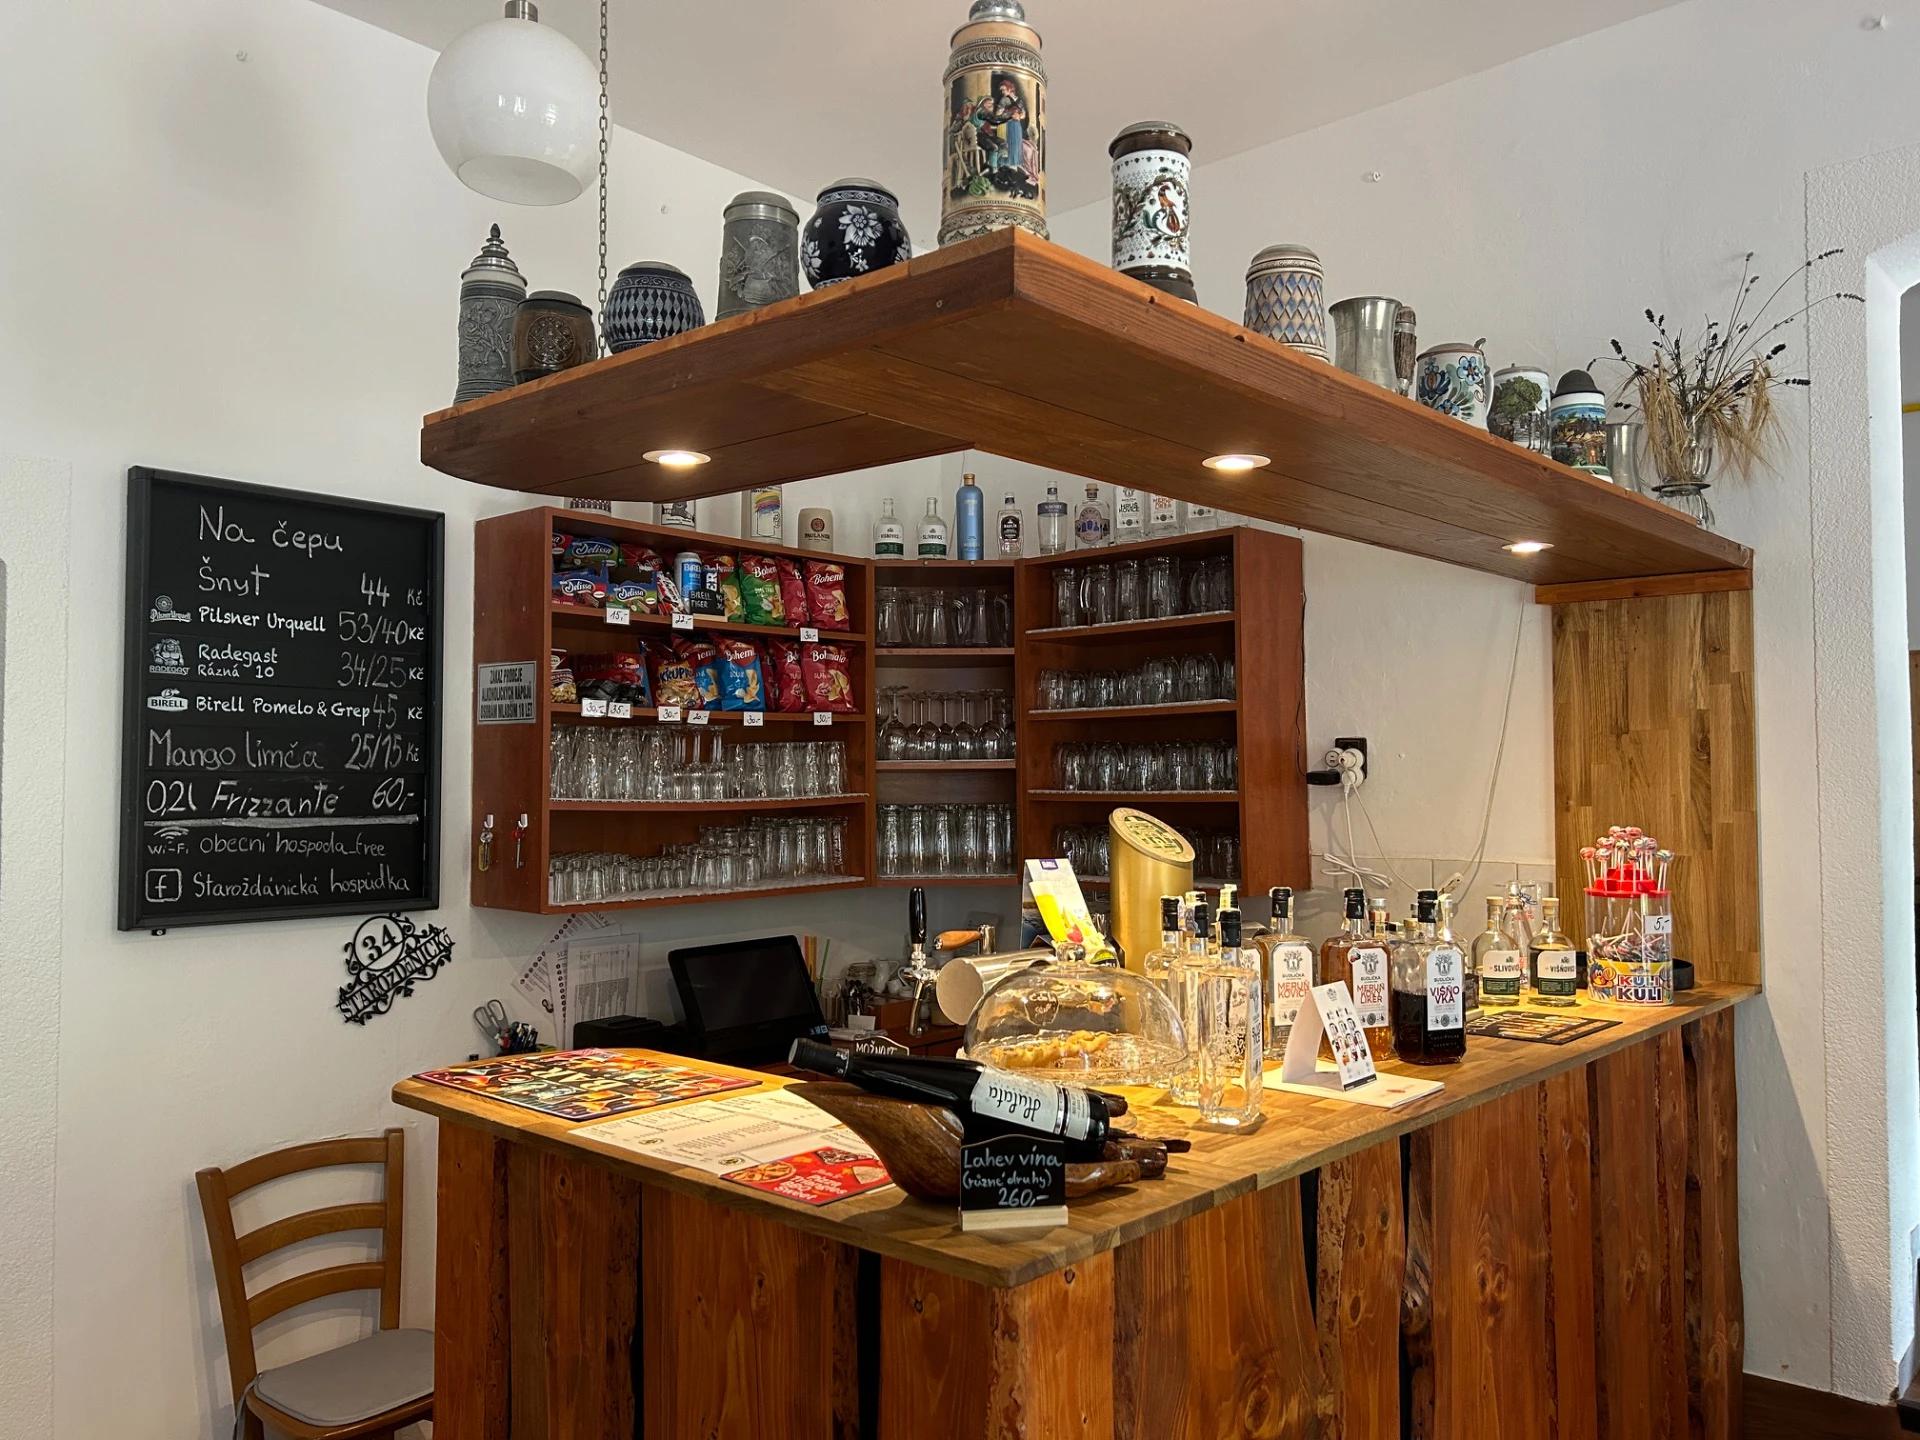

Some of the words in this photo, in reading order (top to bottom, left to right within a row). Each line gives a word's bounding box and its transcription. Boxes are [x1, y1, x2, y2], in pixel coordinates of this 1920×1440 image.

[199, 504, 255, 542] Na
[271, 519, 344, 559] čepu
[576, 543, 612, 554] Delissa
[198, 555, 270, 597] Šnyt
[360, 570, 390, 608] 44
[406, 588, 423, 606] Kč
[565, 581, 592, 592] Delissa
[618, 588, 644, 599] Delissa
[199, 606, 260, 628] Pilsner
[266, 614, 326, 638] Urquell
[338, 610, 408, 646] 53/40
[408, 627, 425, 642] Kč
[149, 665, 191, 676] RADEGAST
[197, 663, 240, 678] Rázná
[255, 666, 274, 679] 10
[198, 644, 278, 668] Radegast
[337, 651, 408, 688] 34/25
[408, 666, 425, 681] Kč
[150, 699, 185, 708] BIRELL
[196, 696, 245, 713] Birell
[253, 700, 313, 716] Pomelo
[316, 702, 327, 716] &
[330, 702, 370, 726] Grep
[372, 694, 398, 730] 45
[407, 707, 423, 720] Kč
[148, 728, 236, 772] Mango
[344, 732, 402, 770] 25/15
[372, 778, 415, 812] 60,-
[200, 831, 270, 854] obecní
[1654, 916, 1670, 930] 5,-
[362, 924, 396, 960] 34
[1430, 984, 1460, 997] VIŠŇO
[1434, 994, 1456, 1004] VKA
[1617, 988, 1662, 1001] KULI
[964, 1147, 1014, 1168] Lahev
[1018, 1145, 1063, 1168] vína
[998, 1188, 1050, 1208] 260,-
